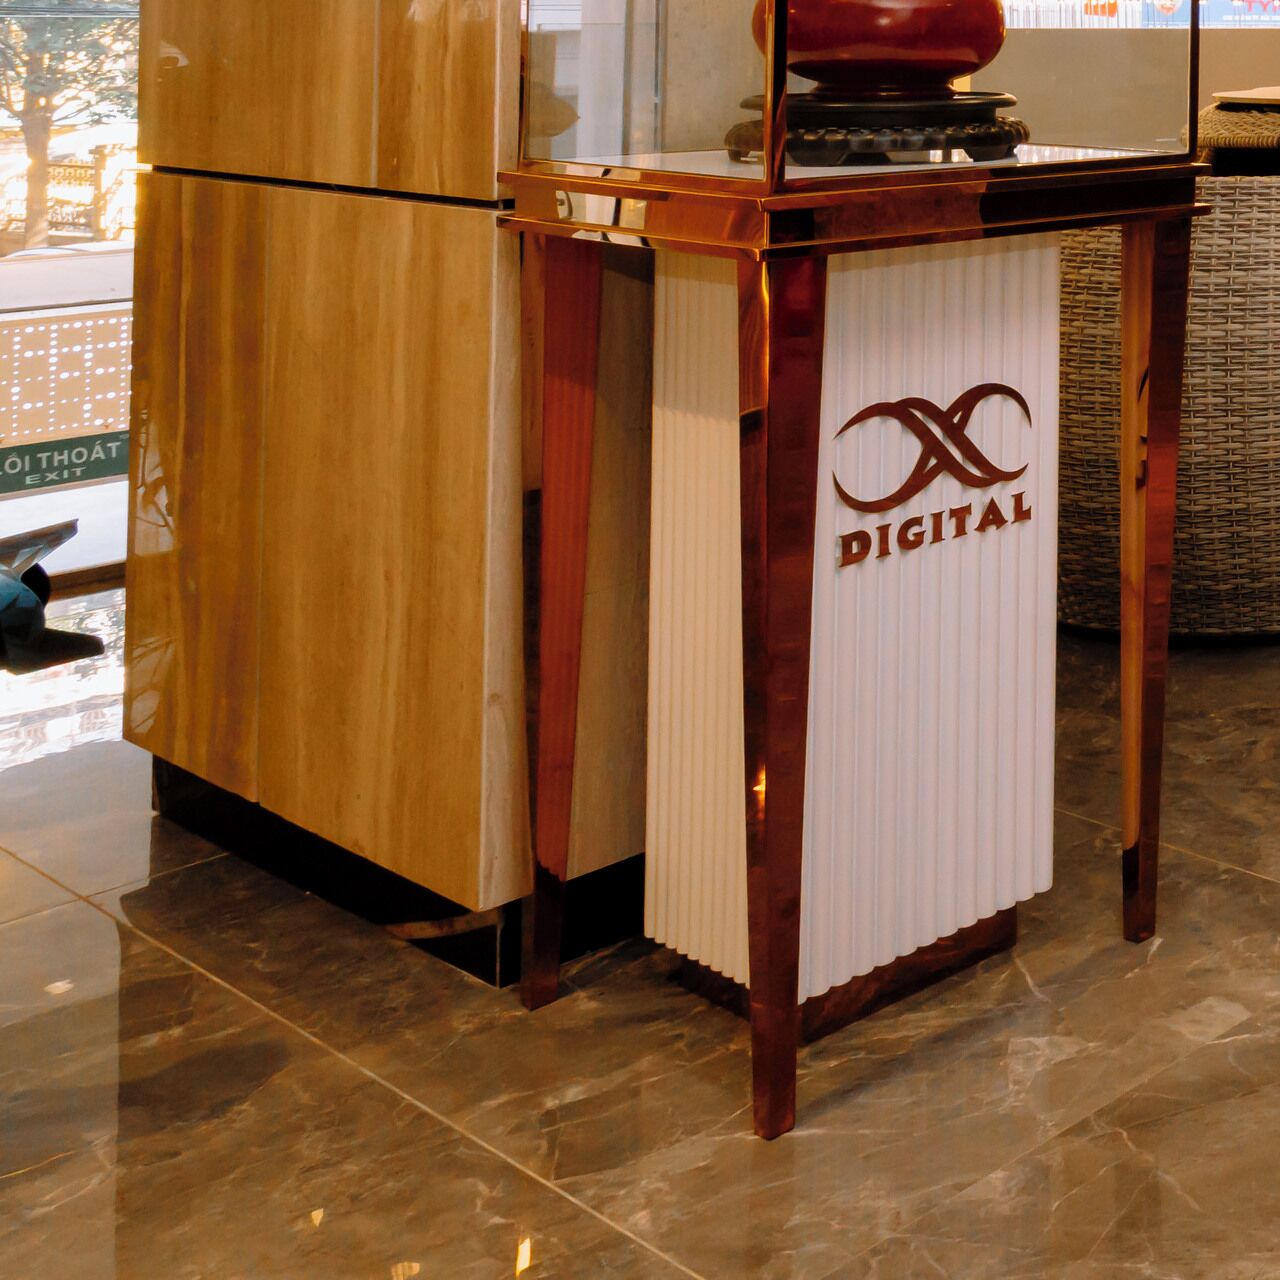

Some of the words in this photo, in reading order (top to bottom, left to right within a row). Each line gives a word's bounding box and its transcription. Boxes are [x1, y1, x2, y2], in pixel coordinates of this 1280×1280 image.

[0, 452, 30, 475] ỐI
[36, 440, 122, 468] THOÁT
[25, 467, 86, 484] EXIT
[840, 491, 1032, 567] DIGITAL
